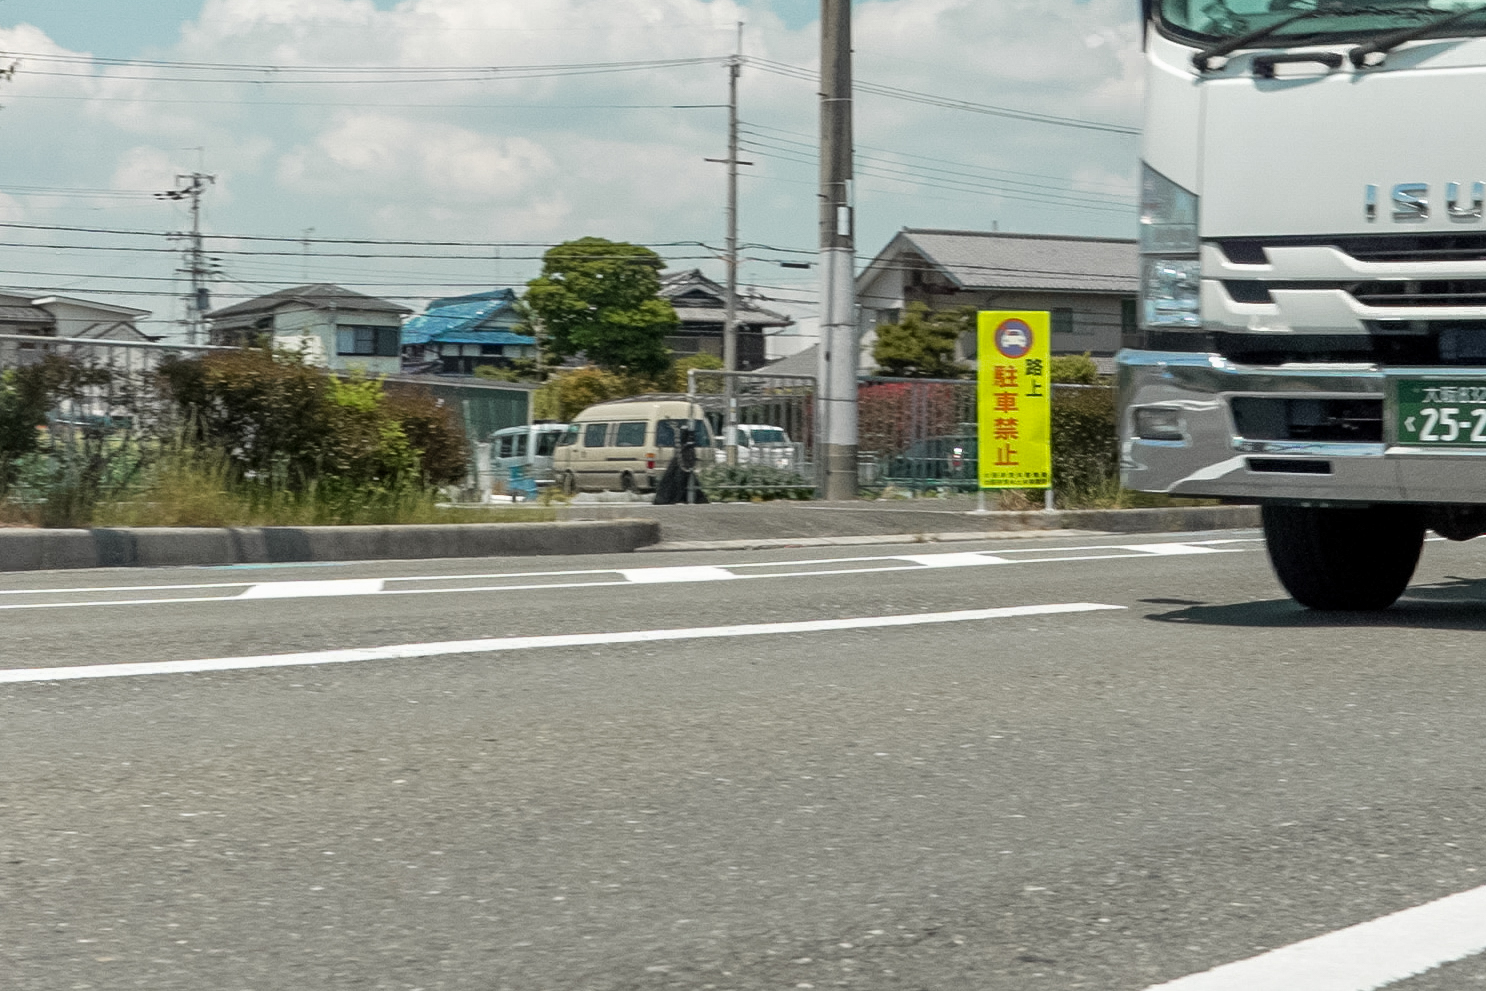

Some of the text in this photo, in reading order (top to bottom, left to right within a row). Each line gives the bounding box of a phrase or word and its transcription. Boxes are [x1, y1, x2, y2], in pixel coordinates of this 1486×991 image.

[1025, 359, 1043, 397] 路上
[993, 365, 1019, 466] 駐車禁止
